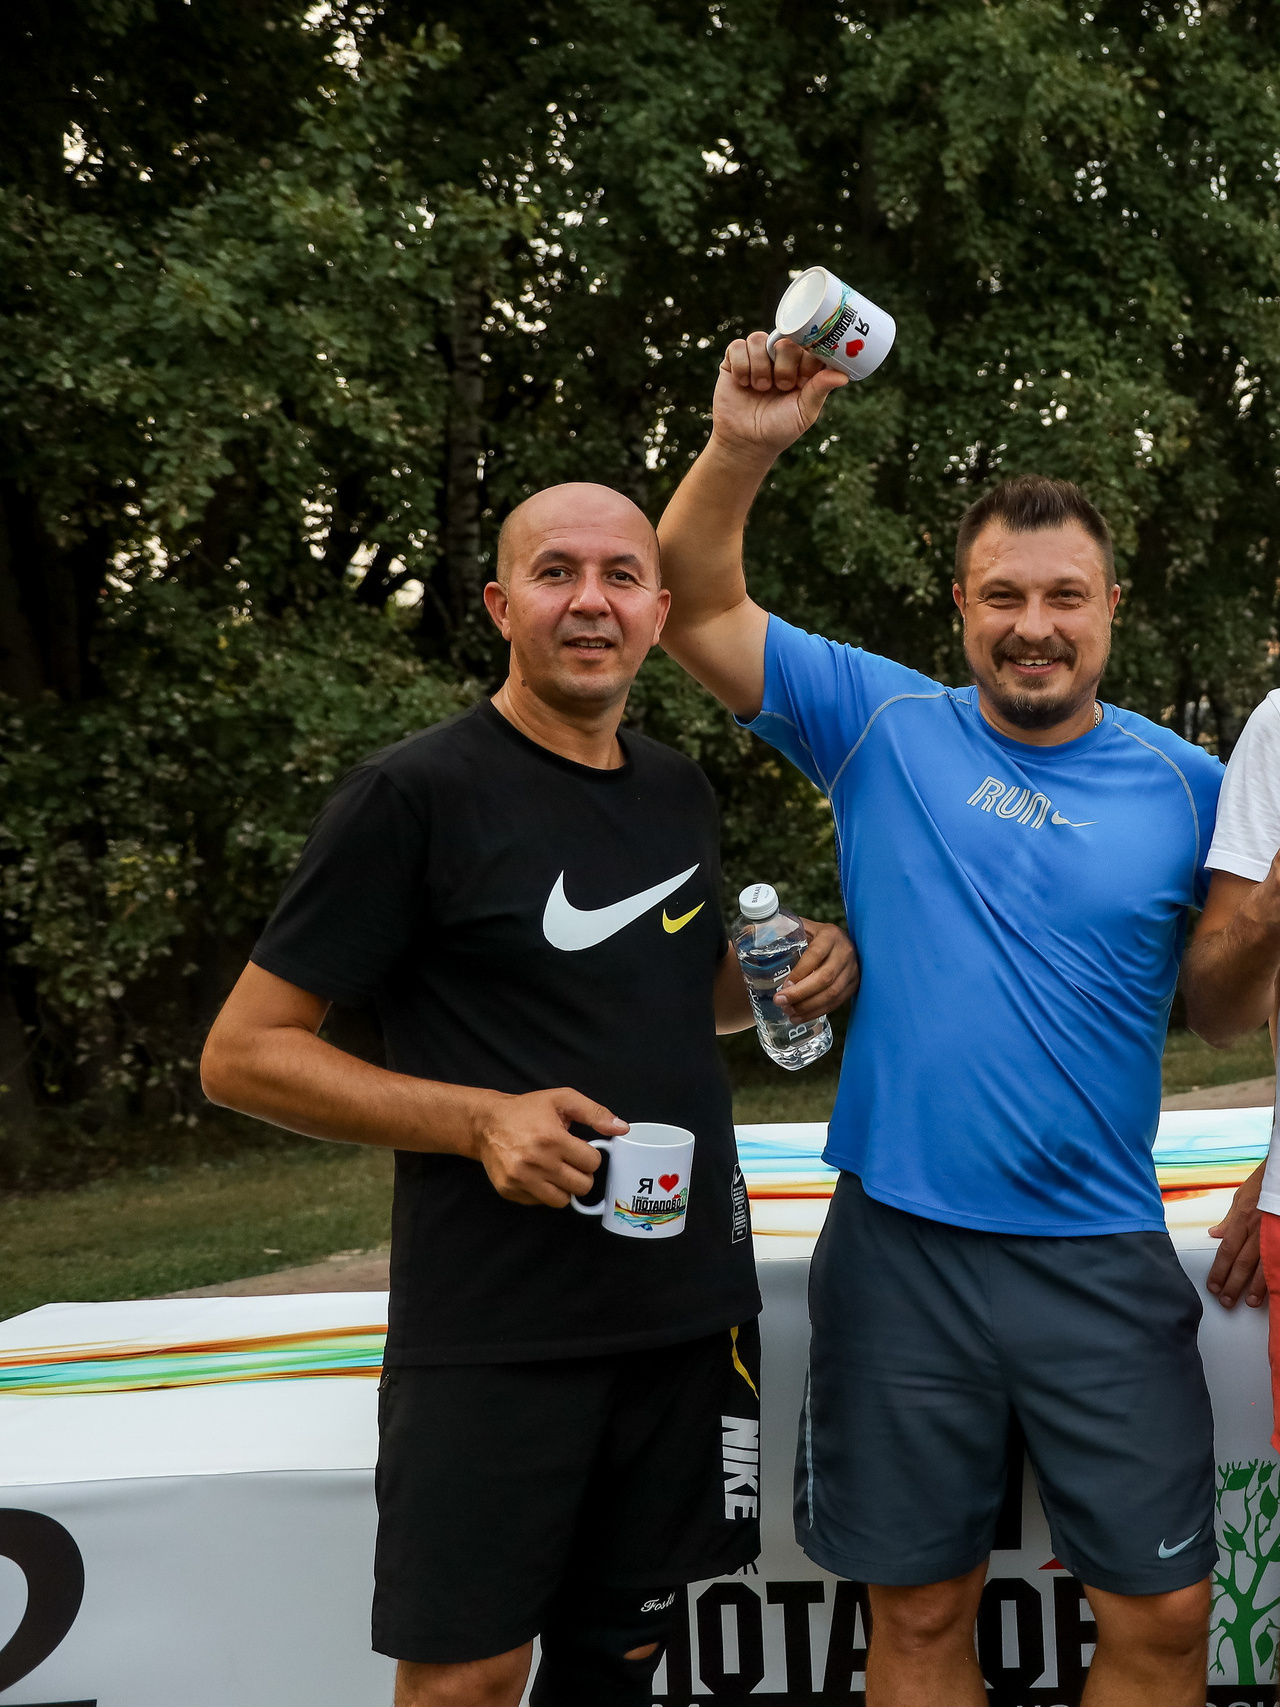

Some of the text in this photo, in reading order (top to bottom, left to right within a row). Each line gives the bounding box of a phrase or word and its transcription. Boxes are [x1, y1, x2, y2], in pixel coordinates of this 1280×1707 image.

[854, 317, 870, 337] Я
[966, 775, 1052, 829] RUN
[637, 1178, 654, 1194] Я
[635, 1198, 681, 1212] ПОТАПОВО
[721, 1415, 759, 1520] NIKE
